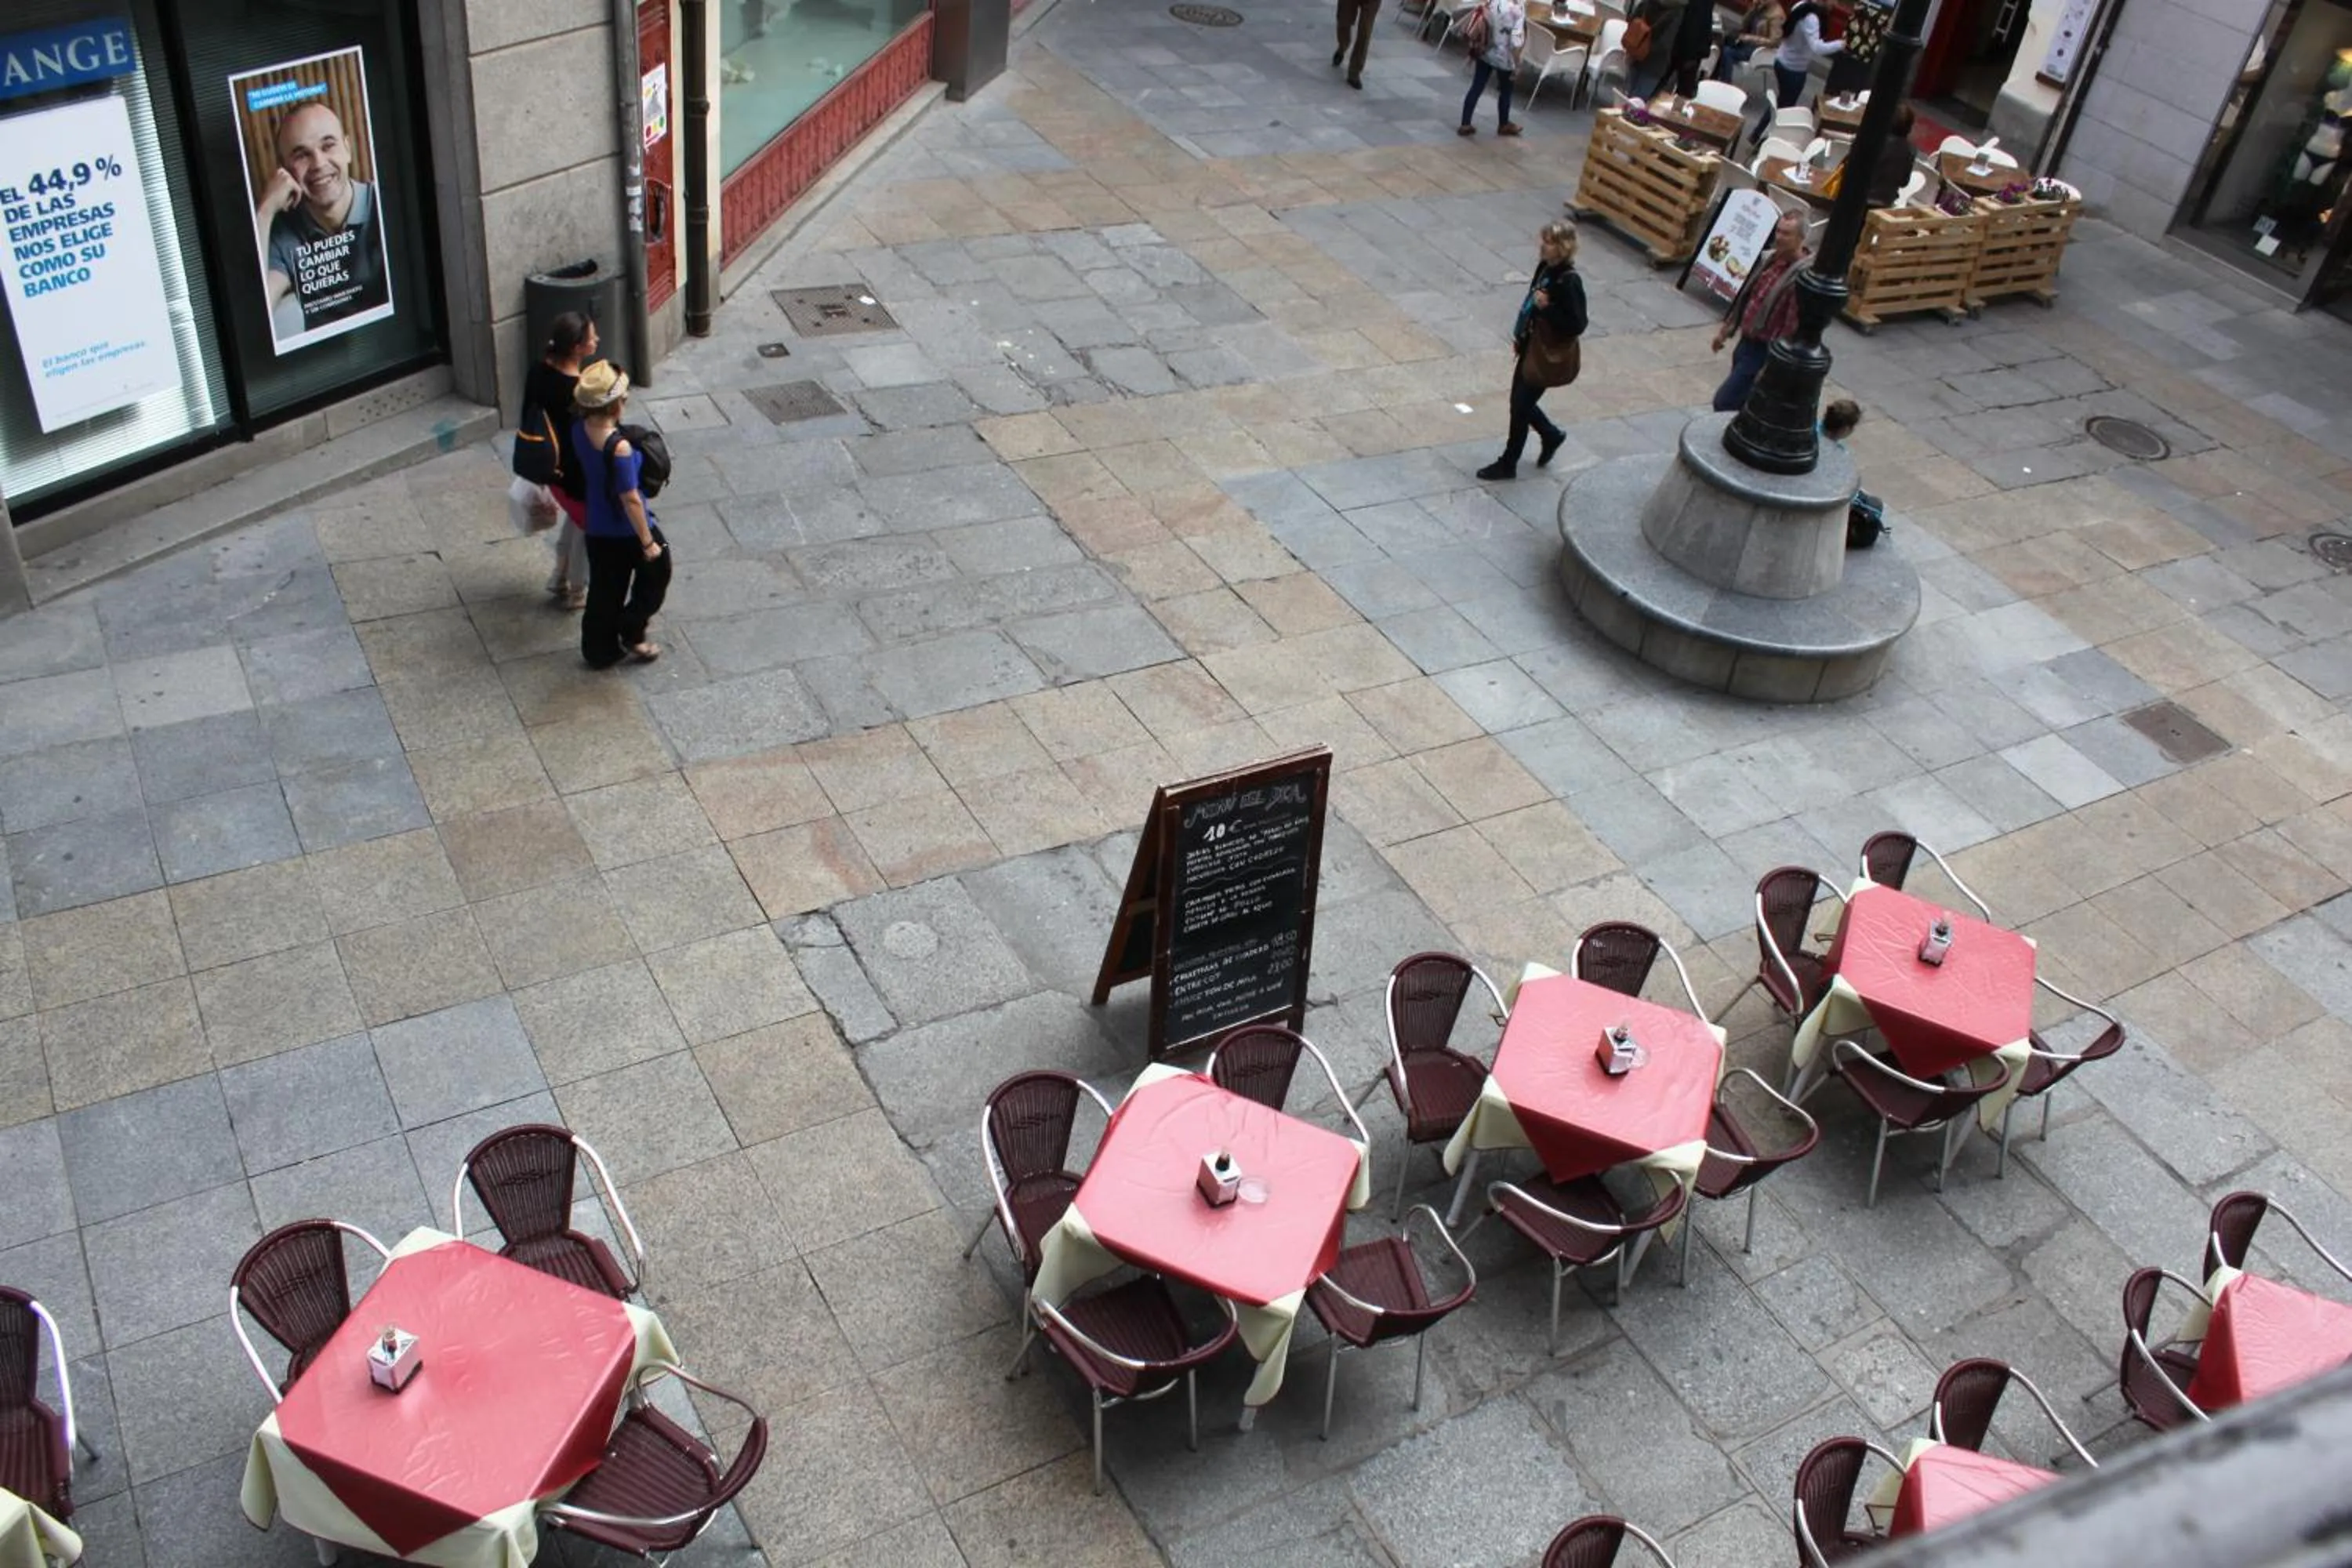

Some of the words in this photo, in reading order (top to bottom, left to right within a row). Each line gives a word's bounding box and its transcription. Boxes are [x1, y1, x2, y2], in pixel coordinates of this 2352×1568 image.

[4, 31, 129, 86] ANGE
[0, 187, 24, 205] EL
[28, 162, 91, 195] 44,9
[96, 154, 122, 180] %
[4, 204, 31, 223] DE
[36, 193, 75, 216] LAS
[9, 201, 115, 242] EMPRESAS
[13, 238, 56, 261] NOS
[60, 222, 113, 249] ELIGE
[314, 230, 355, 252] PUEDES
[19, 252, 76, 278] COMO
[80, 243, 106, 262] SU
[299, 245, 350, 270] CAMBIAR
[300, 269, 315, 282] LO
[318, 260, 340, 276] QUE
[23, 267, 90, 298] BANCO
[302, 270, 350, 294] QUIERAS
